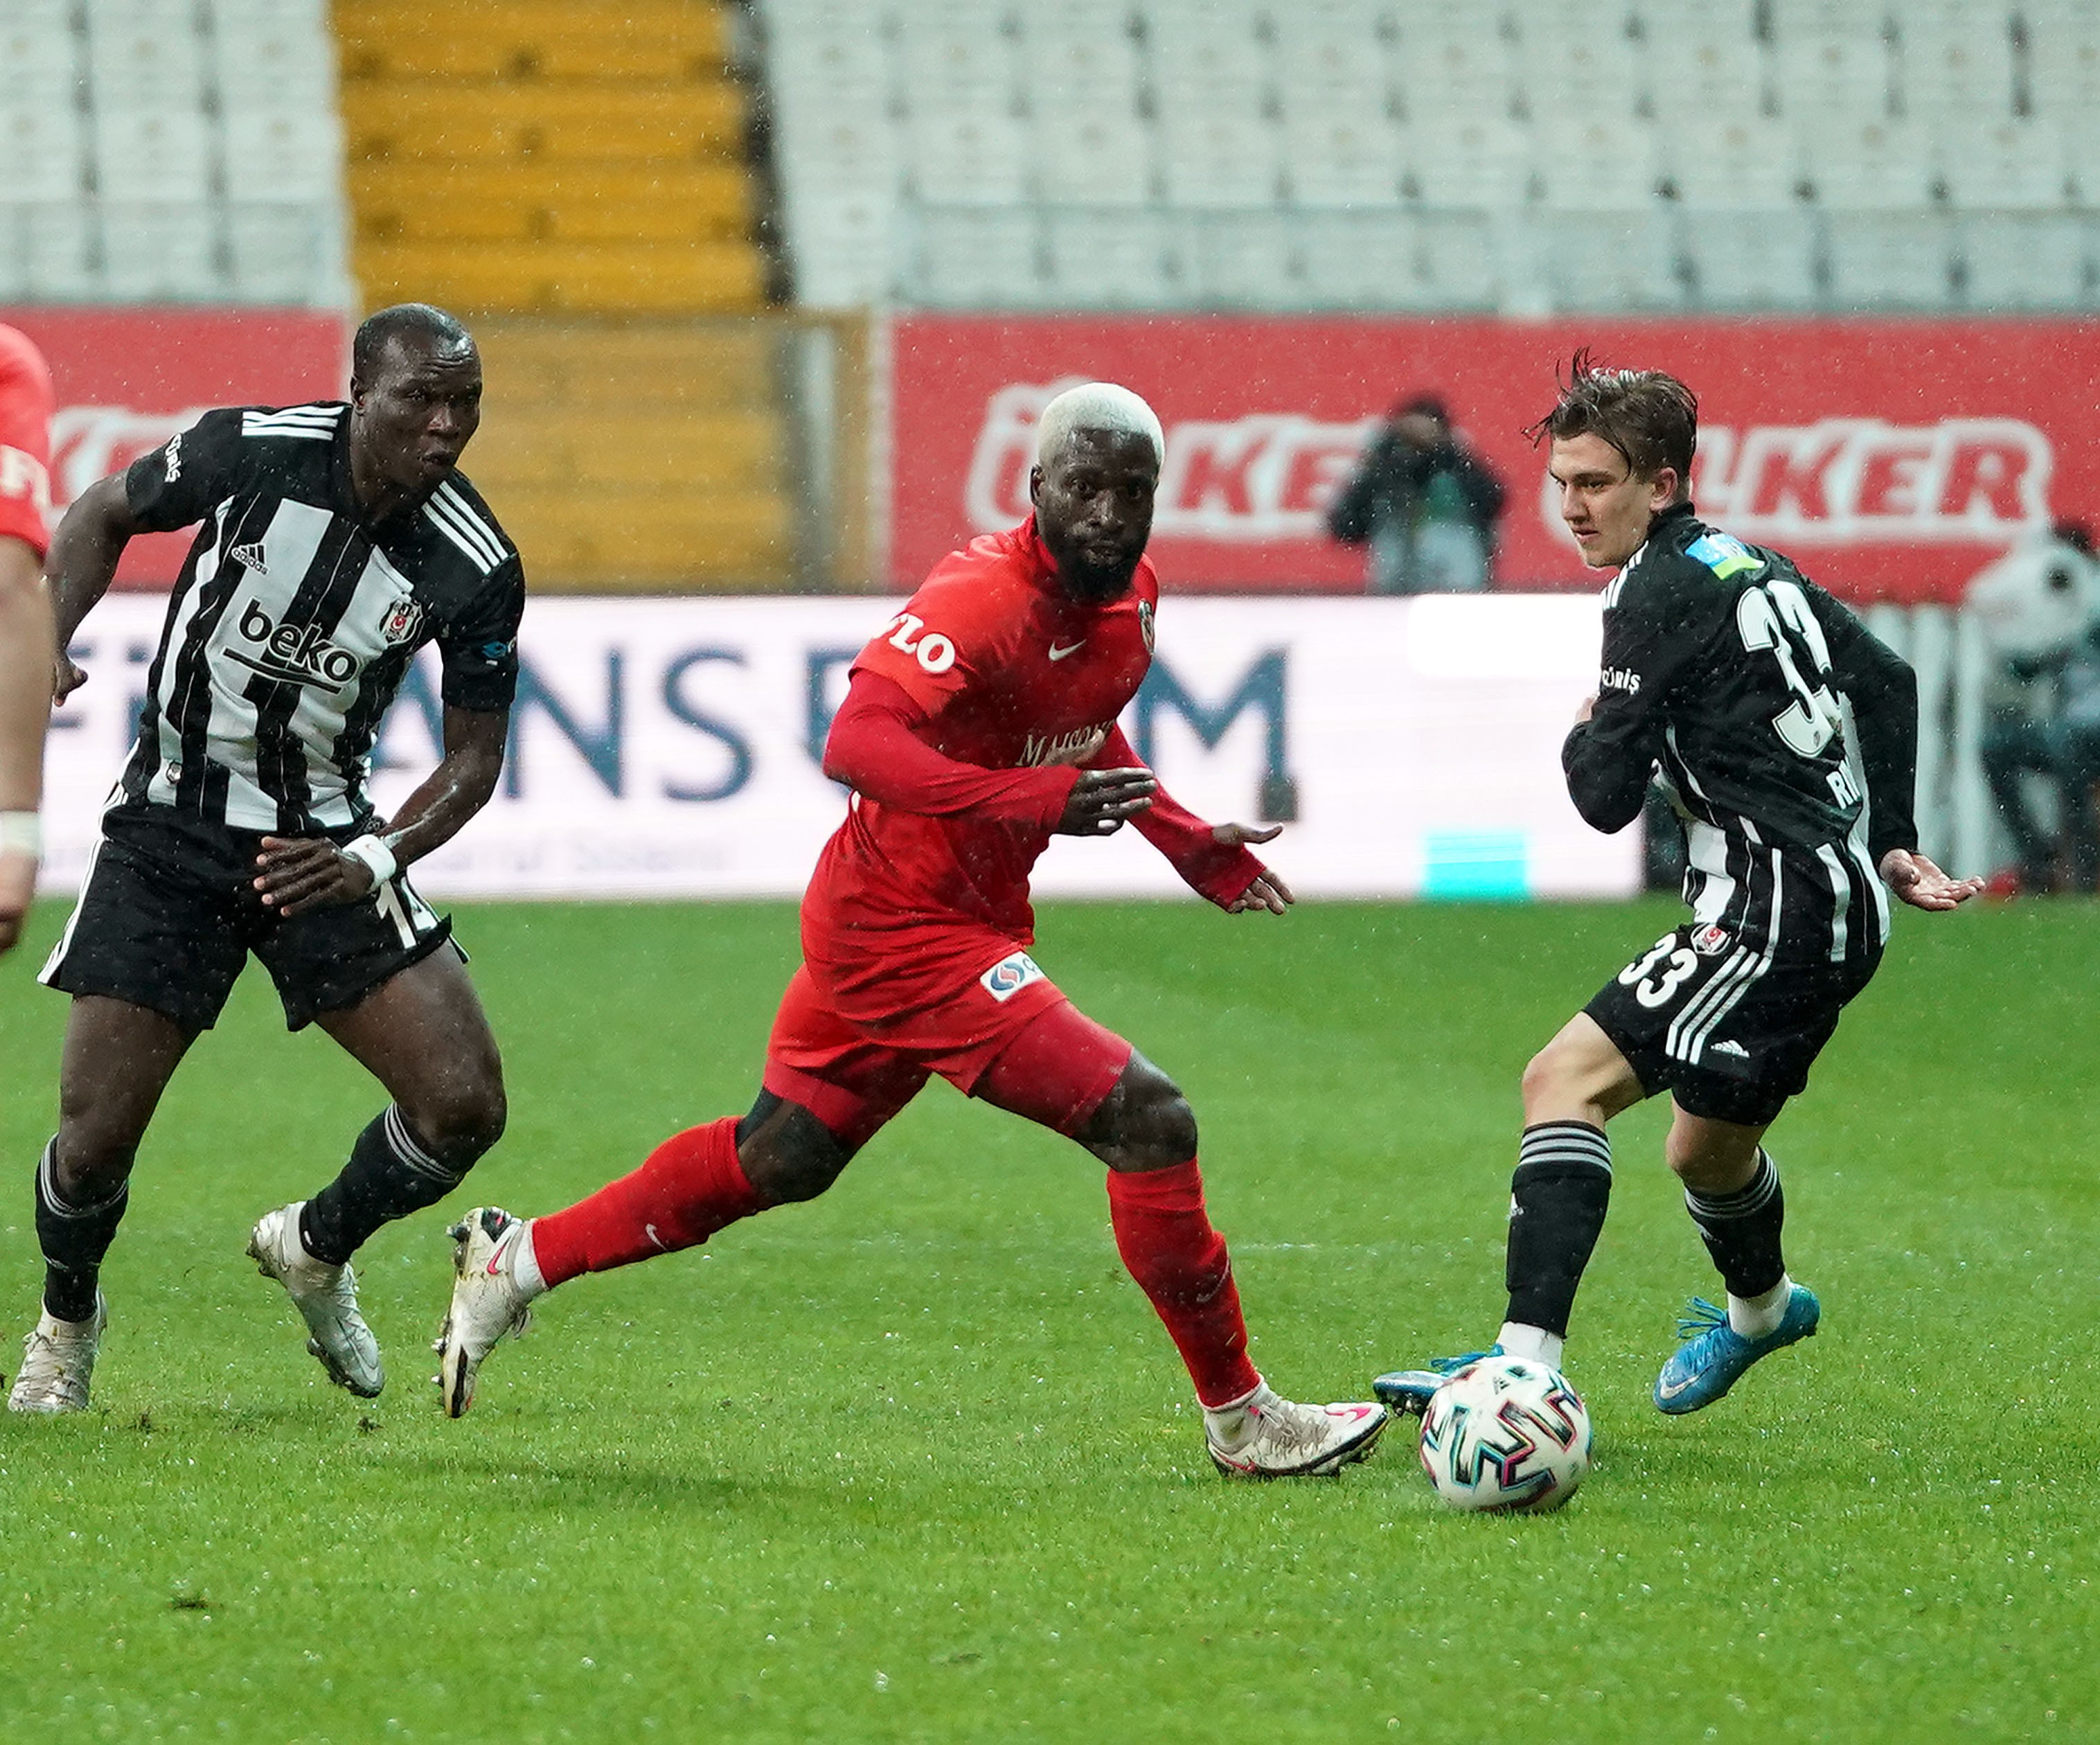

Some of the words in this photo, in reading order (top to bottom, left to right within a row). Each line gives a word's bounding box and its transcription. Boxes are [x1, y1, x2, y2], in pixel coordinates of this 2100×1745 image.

[1539, 416, 2054, 551] LKER
[231, 546, 270, 576] adidas
[238, 596, 359, 682] beko
[1617, 932, 1699, 1009] 33
